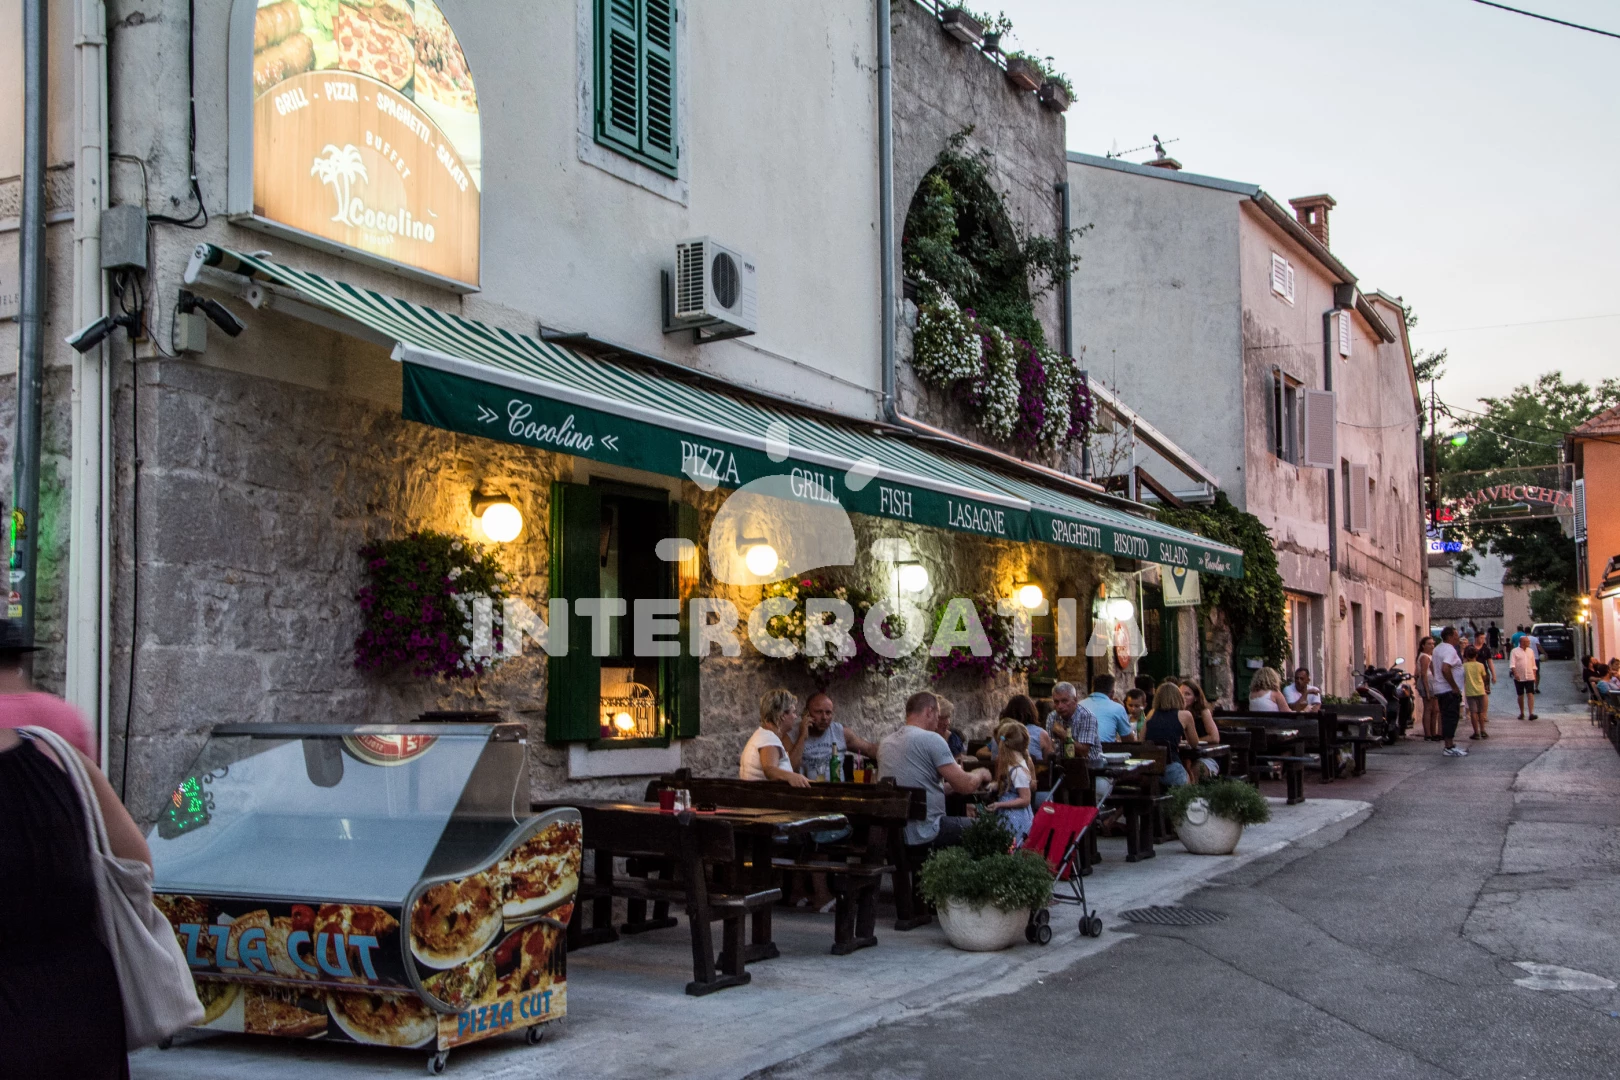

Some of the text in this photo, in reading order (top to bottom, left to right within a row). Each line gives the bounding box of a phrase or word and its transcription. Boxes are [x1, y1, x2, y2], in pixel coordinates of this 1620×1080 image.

[275, 82, 469, 193] GRILL PIZZA SPAGHETTI SALATS
[365, 130, 411, 180] BUFFET
[349, 196, 436, 243] Cocolino
[507, 399, 595, 452] Cocolino
[680, 440, 1006, 535] PIZZA GRILL FISH LASAGNE
[1051, 518, 1102, 549] SPAGHETTI
[1113, 532, 1150, 558] RISOTTO
[1159, 542, 1189, 566] SALADS
[179, 923, 380, 981] ZZA CUT
[457, 989, 553, 1037] PIZZA CUT
